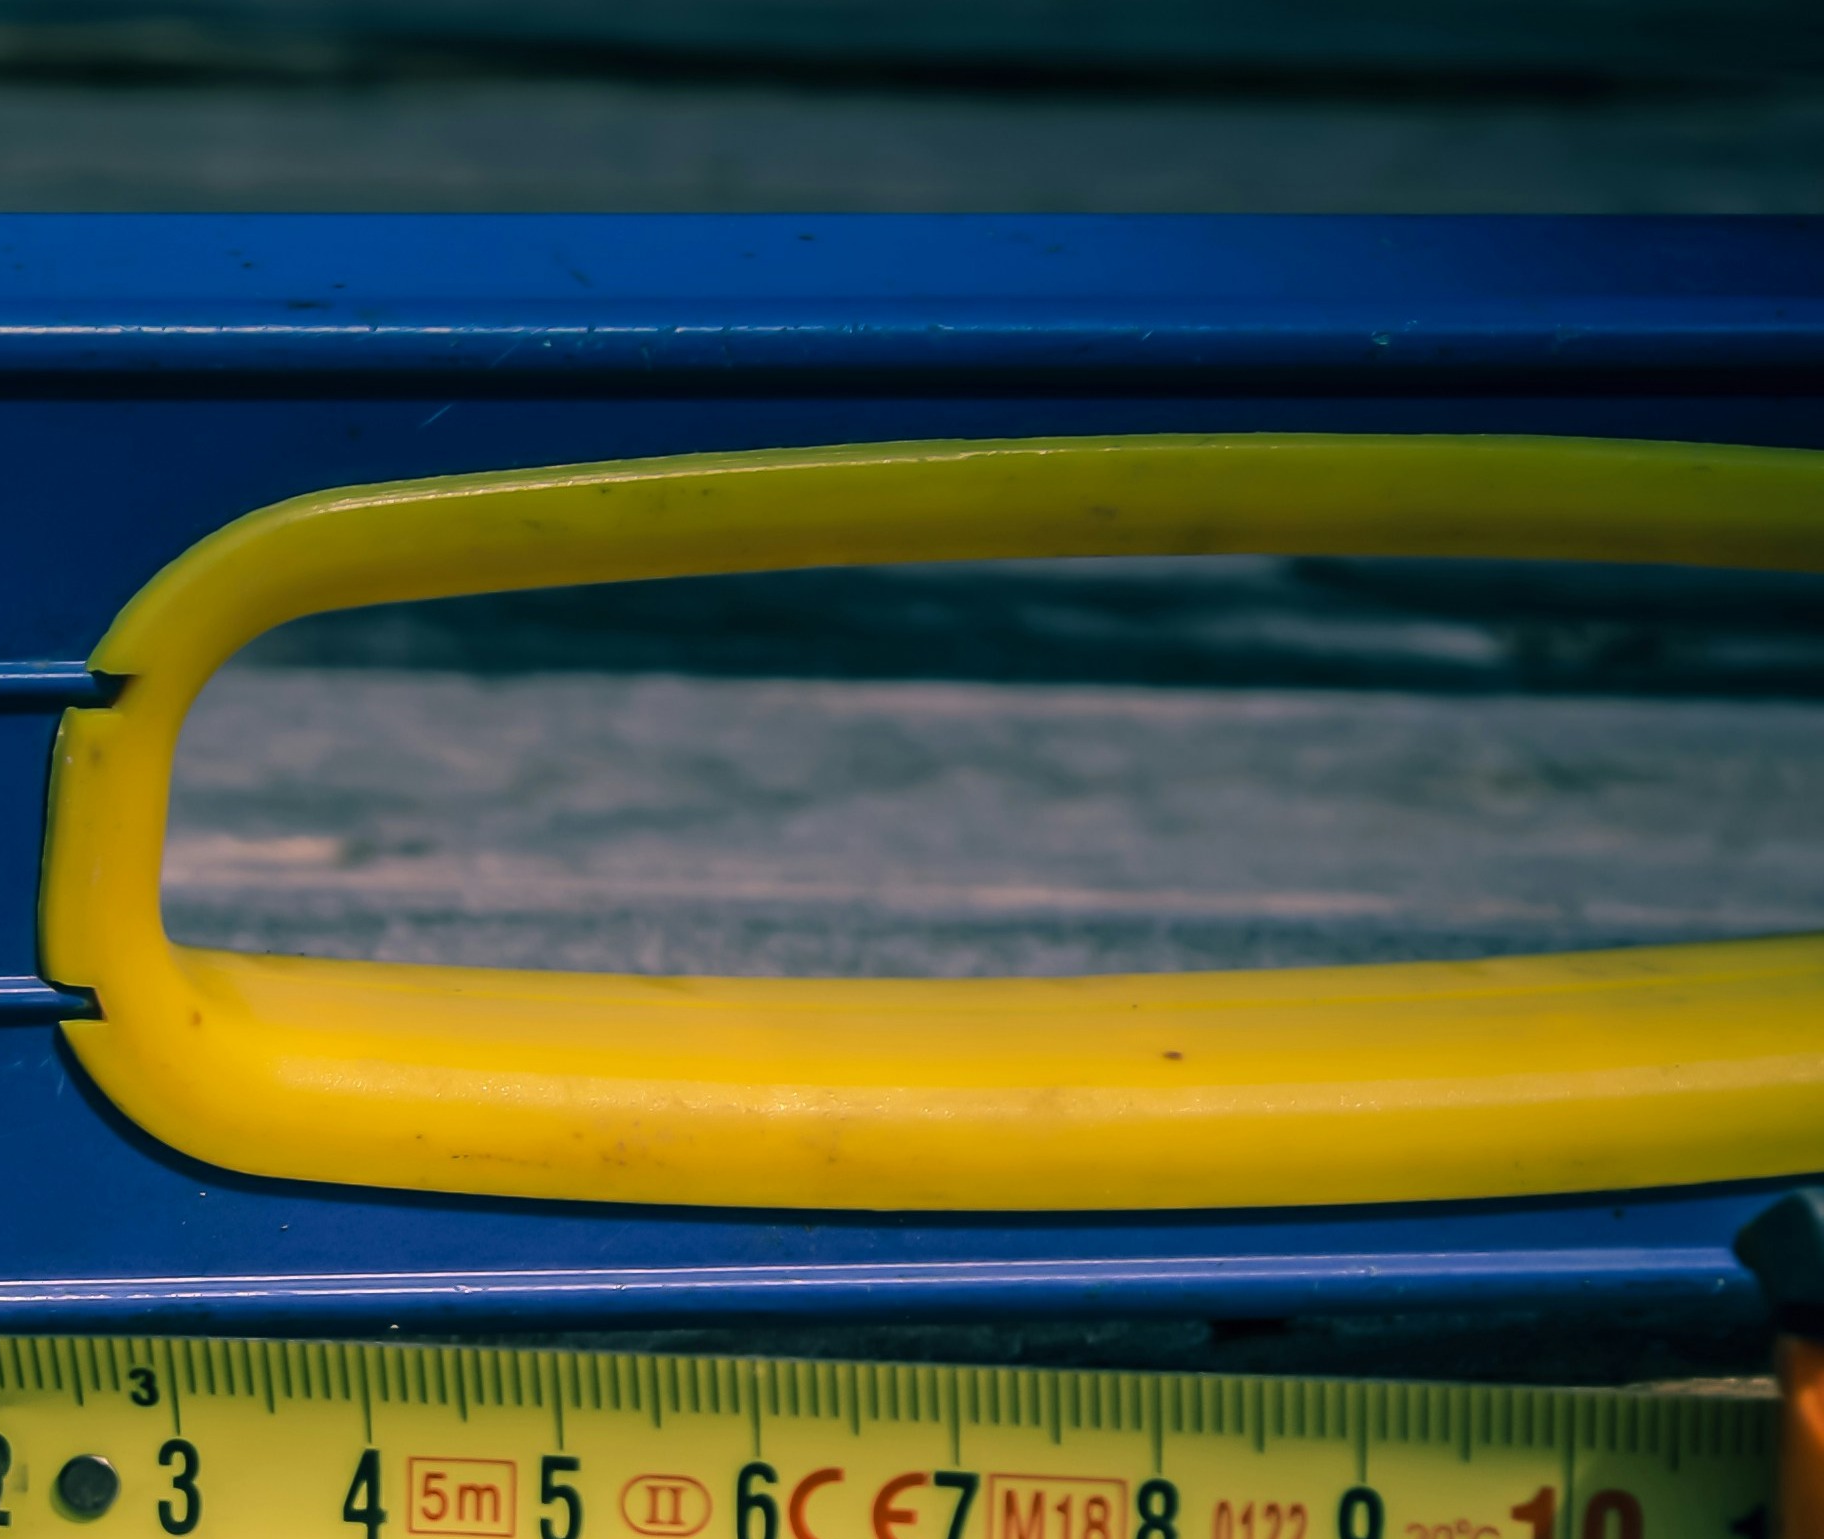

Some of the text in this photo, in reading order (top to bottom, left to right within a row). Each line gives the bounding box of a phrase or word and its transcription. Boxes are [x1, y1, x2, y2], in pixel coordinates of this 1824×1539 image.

[128, 1367, 160, 1407] 3
[157, 1438, 202, 1536] 3
[419, 1471, 502, 1524] 5m
